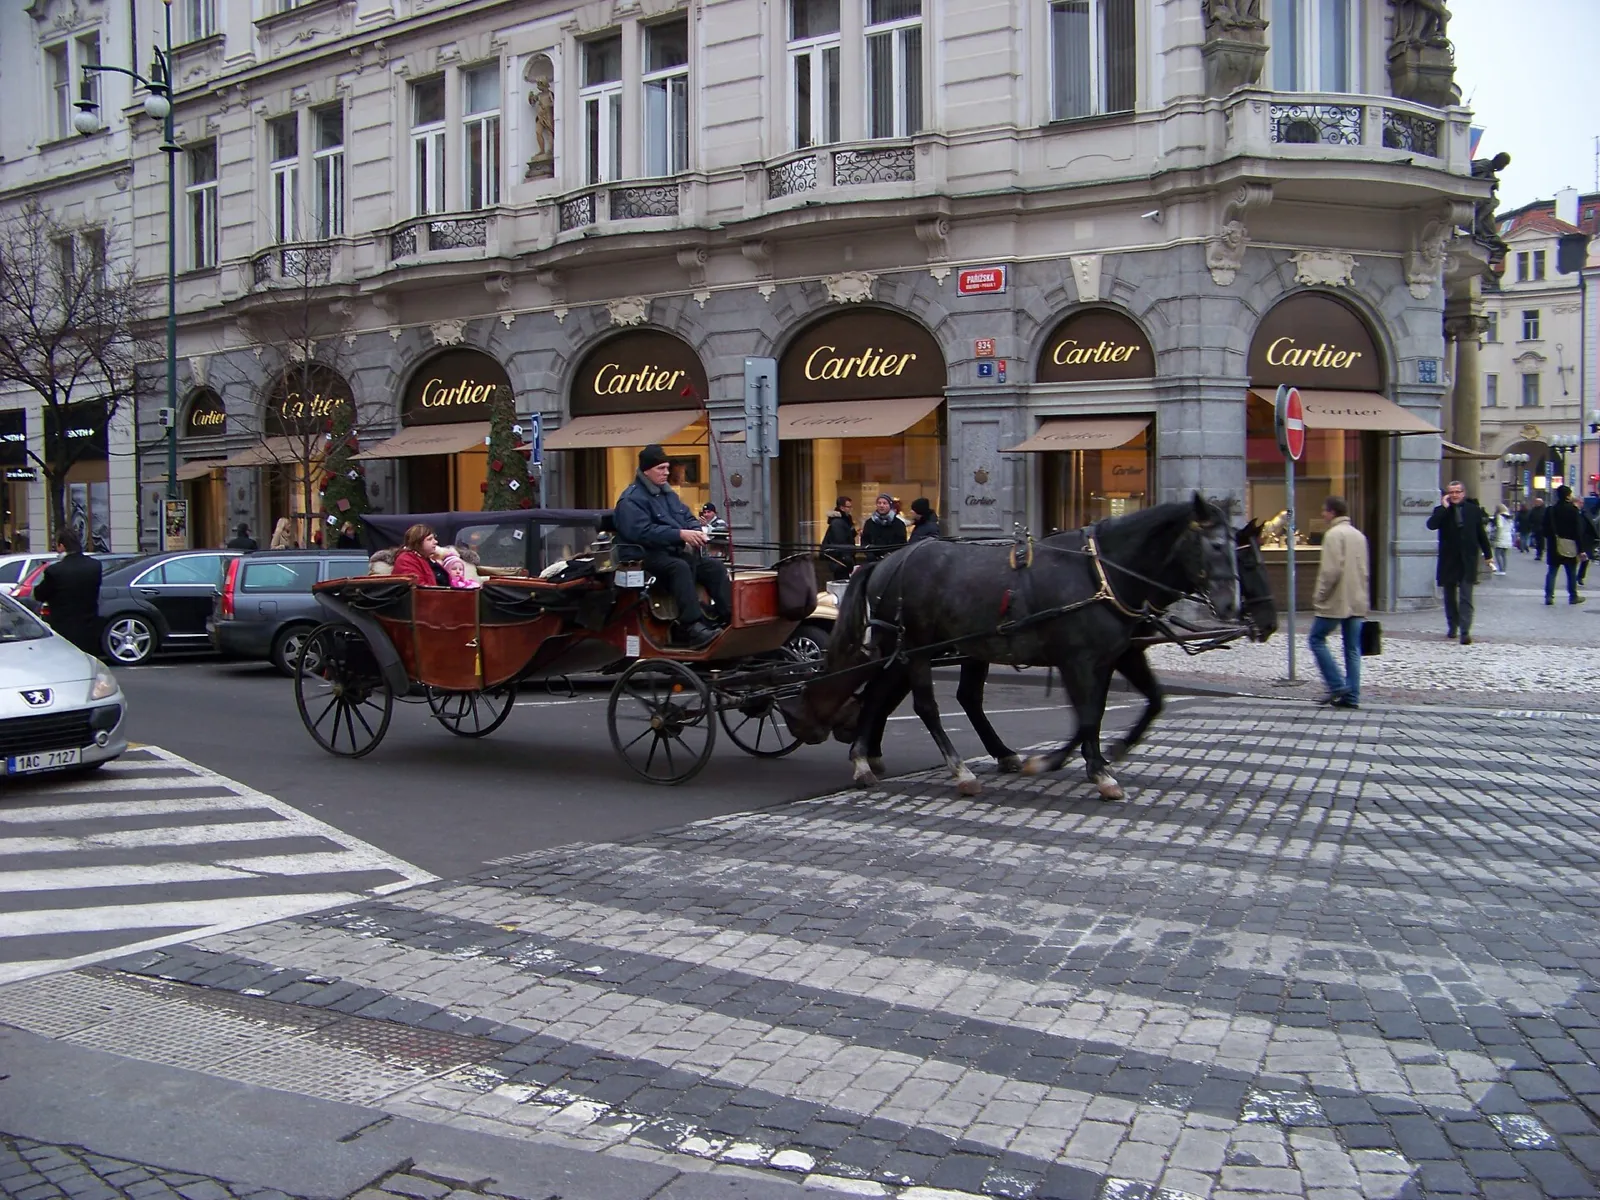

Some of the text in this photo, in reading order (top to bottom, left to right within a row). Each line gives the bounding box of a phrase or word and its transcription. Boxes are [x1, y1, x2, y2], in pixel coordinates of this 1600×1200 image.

[1053, 340, 1140, 365] Cartier
[1266, 337, 1362, 369] Cartier
[804, 345, 917, 381] Cartier
[983, 365, 988, 374] 2
[594, 363, 685, 396] Cartier
[422, 378, 496, 408] Cartier
[282, 393, 344, 419] Catier
[1305, 404, 1383, 417] Cartier
[192, 410, 226, 426] Cartier
[790, 414, 873, 427] Cartier
[1112, 464, 1145, 477] Cartier
[964, 495, 997, 507] Cartier
[19, 750, 76, 769] 1AC 7127
